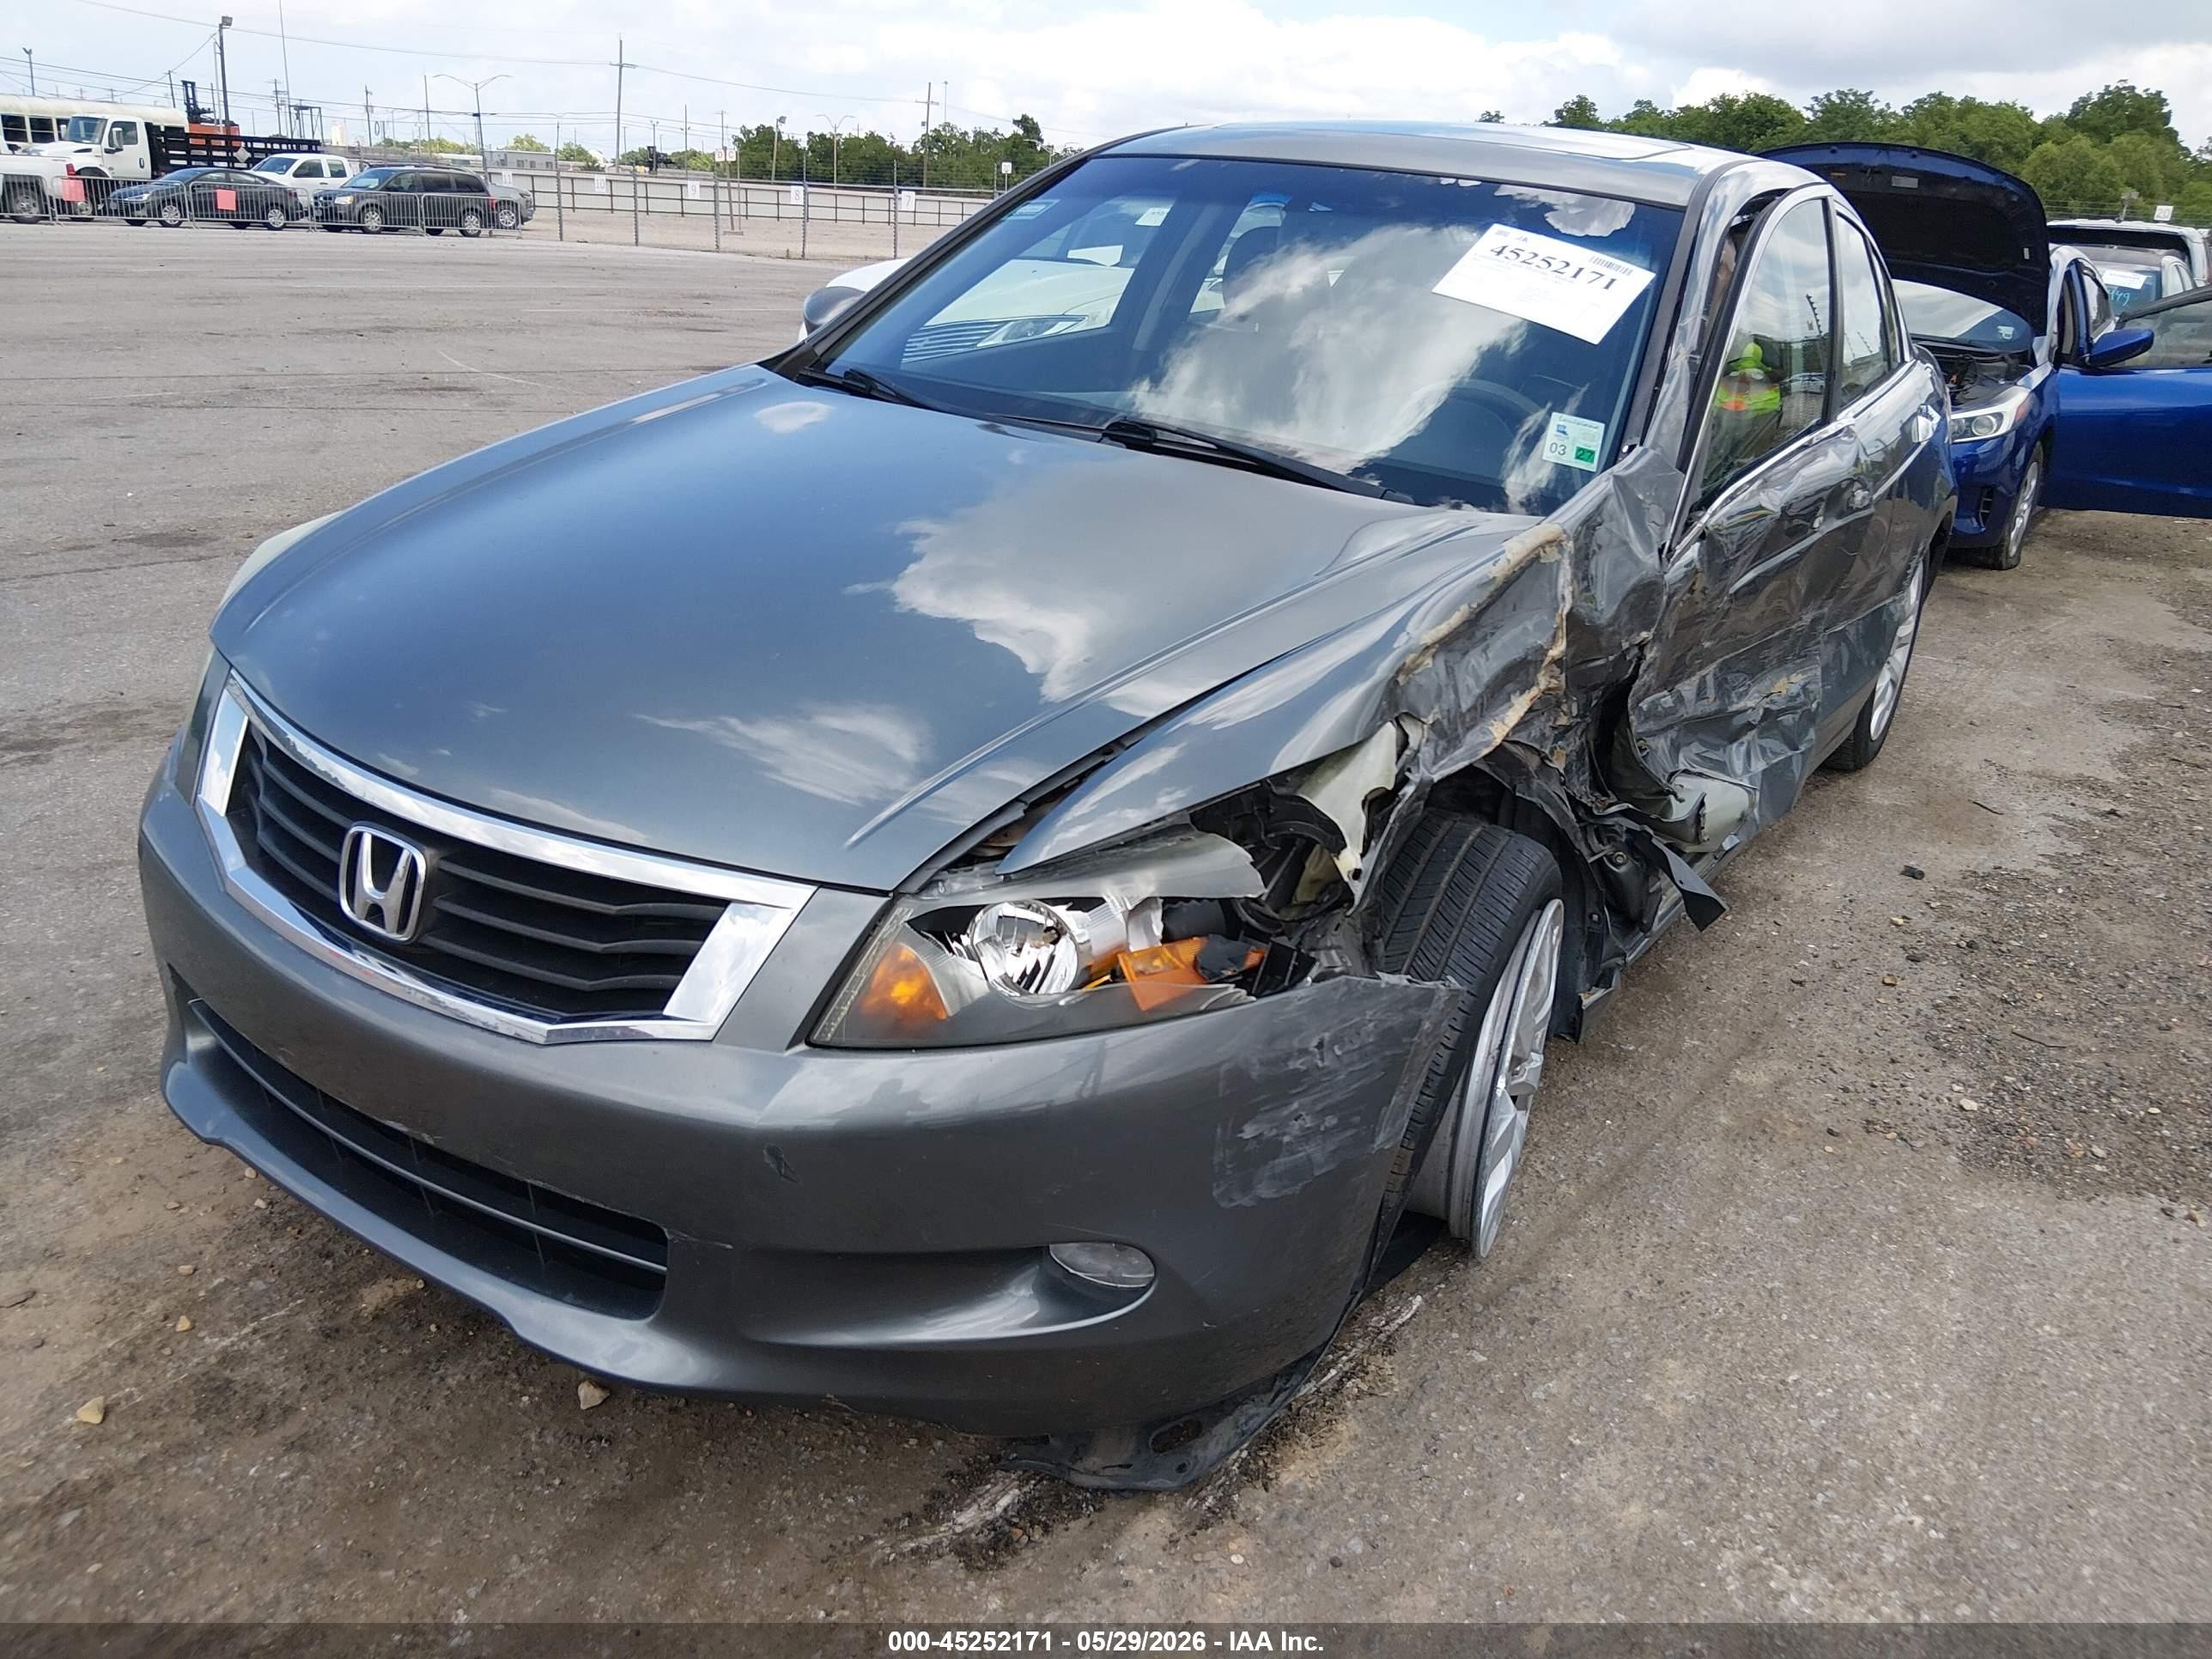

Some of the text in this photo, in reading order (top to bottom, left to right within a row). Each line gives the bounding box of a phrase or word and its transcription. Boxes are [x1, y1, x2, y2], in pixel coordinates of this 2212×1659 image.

[596, 179, 605, 189] 10
[794, 190, 799, 201] 8
[906, 195, 911, 206] 7
[1490, 245, 1617, 290] 45252171
[1549, 442, 1567, 456] 03
[1576, 448, 1595, 461] 27
